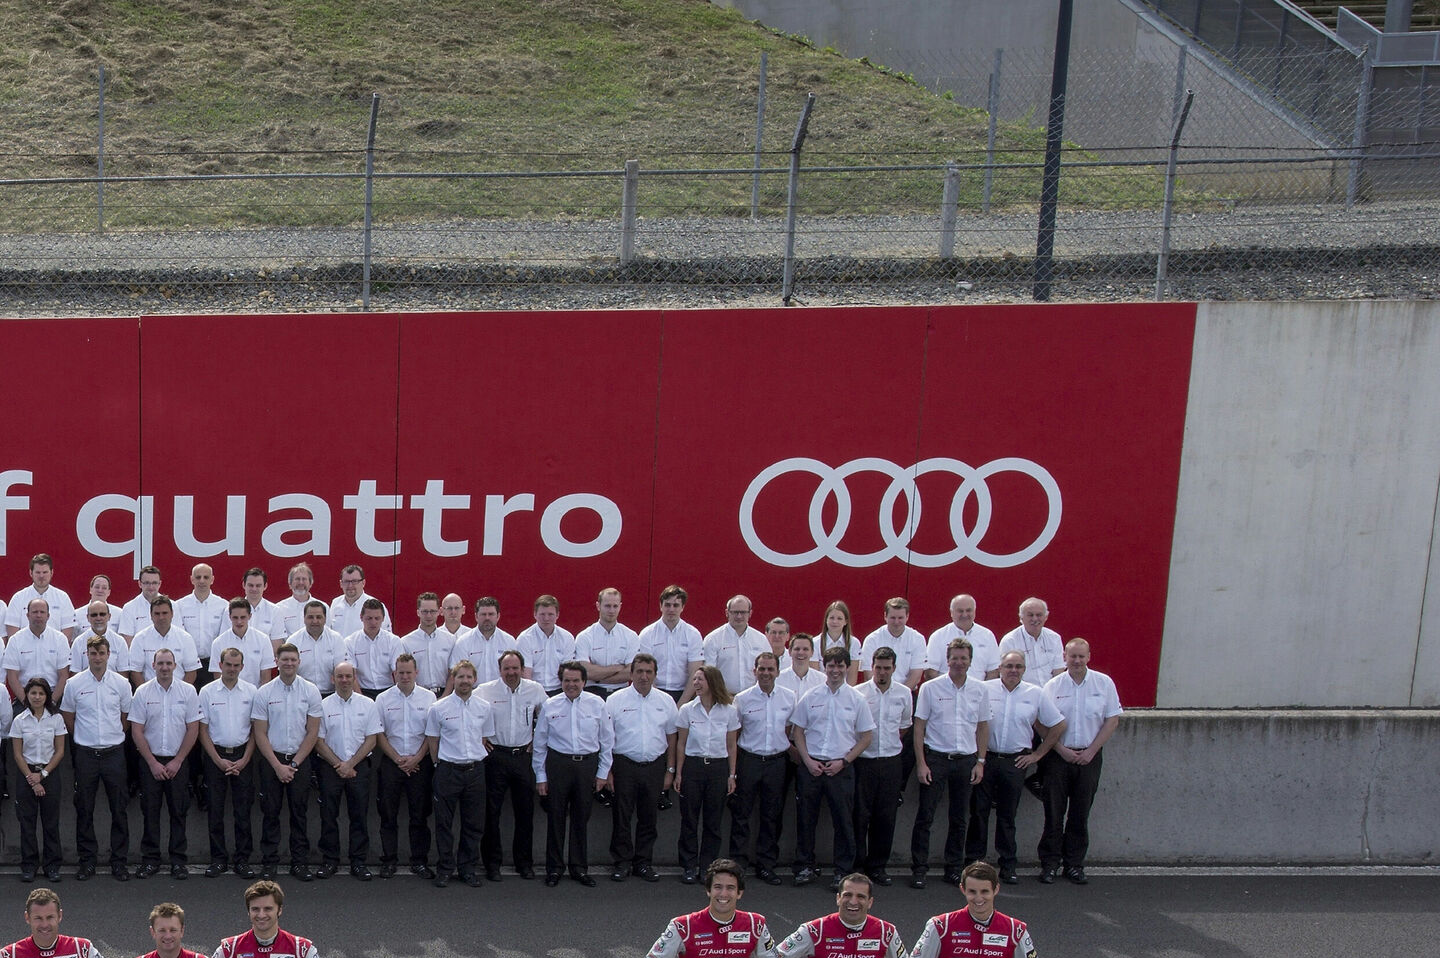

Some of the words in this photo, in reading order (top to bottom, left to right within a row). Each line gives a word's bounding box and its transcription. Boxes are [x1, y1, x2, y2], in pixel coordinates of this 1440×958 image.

[75, 479, 623, 580] quattro
[963, 947, 982, 955] Audi
[983, 948, 1003, 957] Sport
